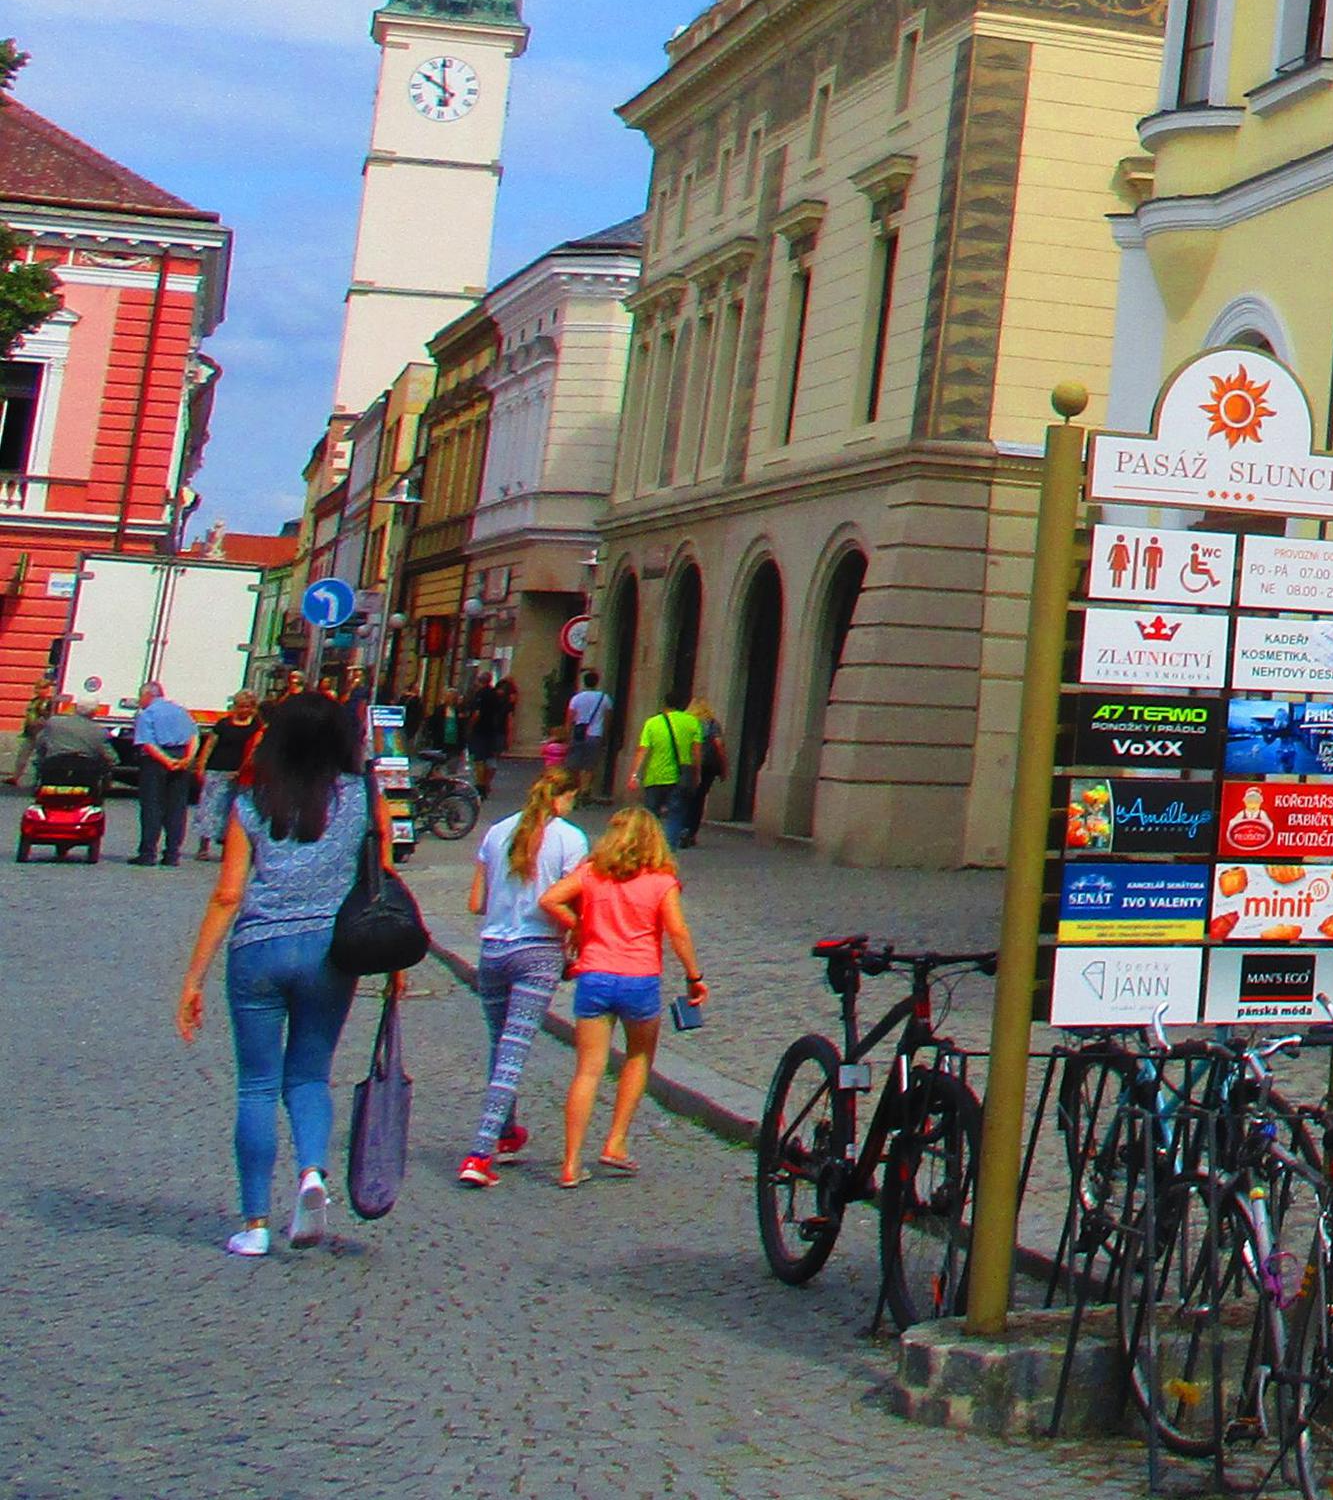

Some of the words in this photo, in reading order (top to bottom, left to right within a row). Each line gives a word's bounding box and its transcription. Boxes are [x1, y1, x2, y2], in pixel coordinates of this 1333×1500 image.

[1114, 449, 1208, 480] PASÁŽ
[1202, 548, 1222, 559] WC
[1250, 564, 1265, 576] PO
[1097, 648, 1213, 670] ZLATNICTVÍ
[1092, 705, 1123, 720] A7
[1132, 707, 1208, 724] TERMO
[1068, 891, 1113, 905] SENÁT
[1122, 897, 1146, 908] IVO
[1150, 897, 1203, 908] VALENTY
[1244, 890, 1314, 917] minit
[1112, 977, 1170, 1000] JANN
